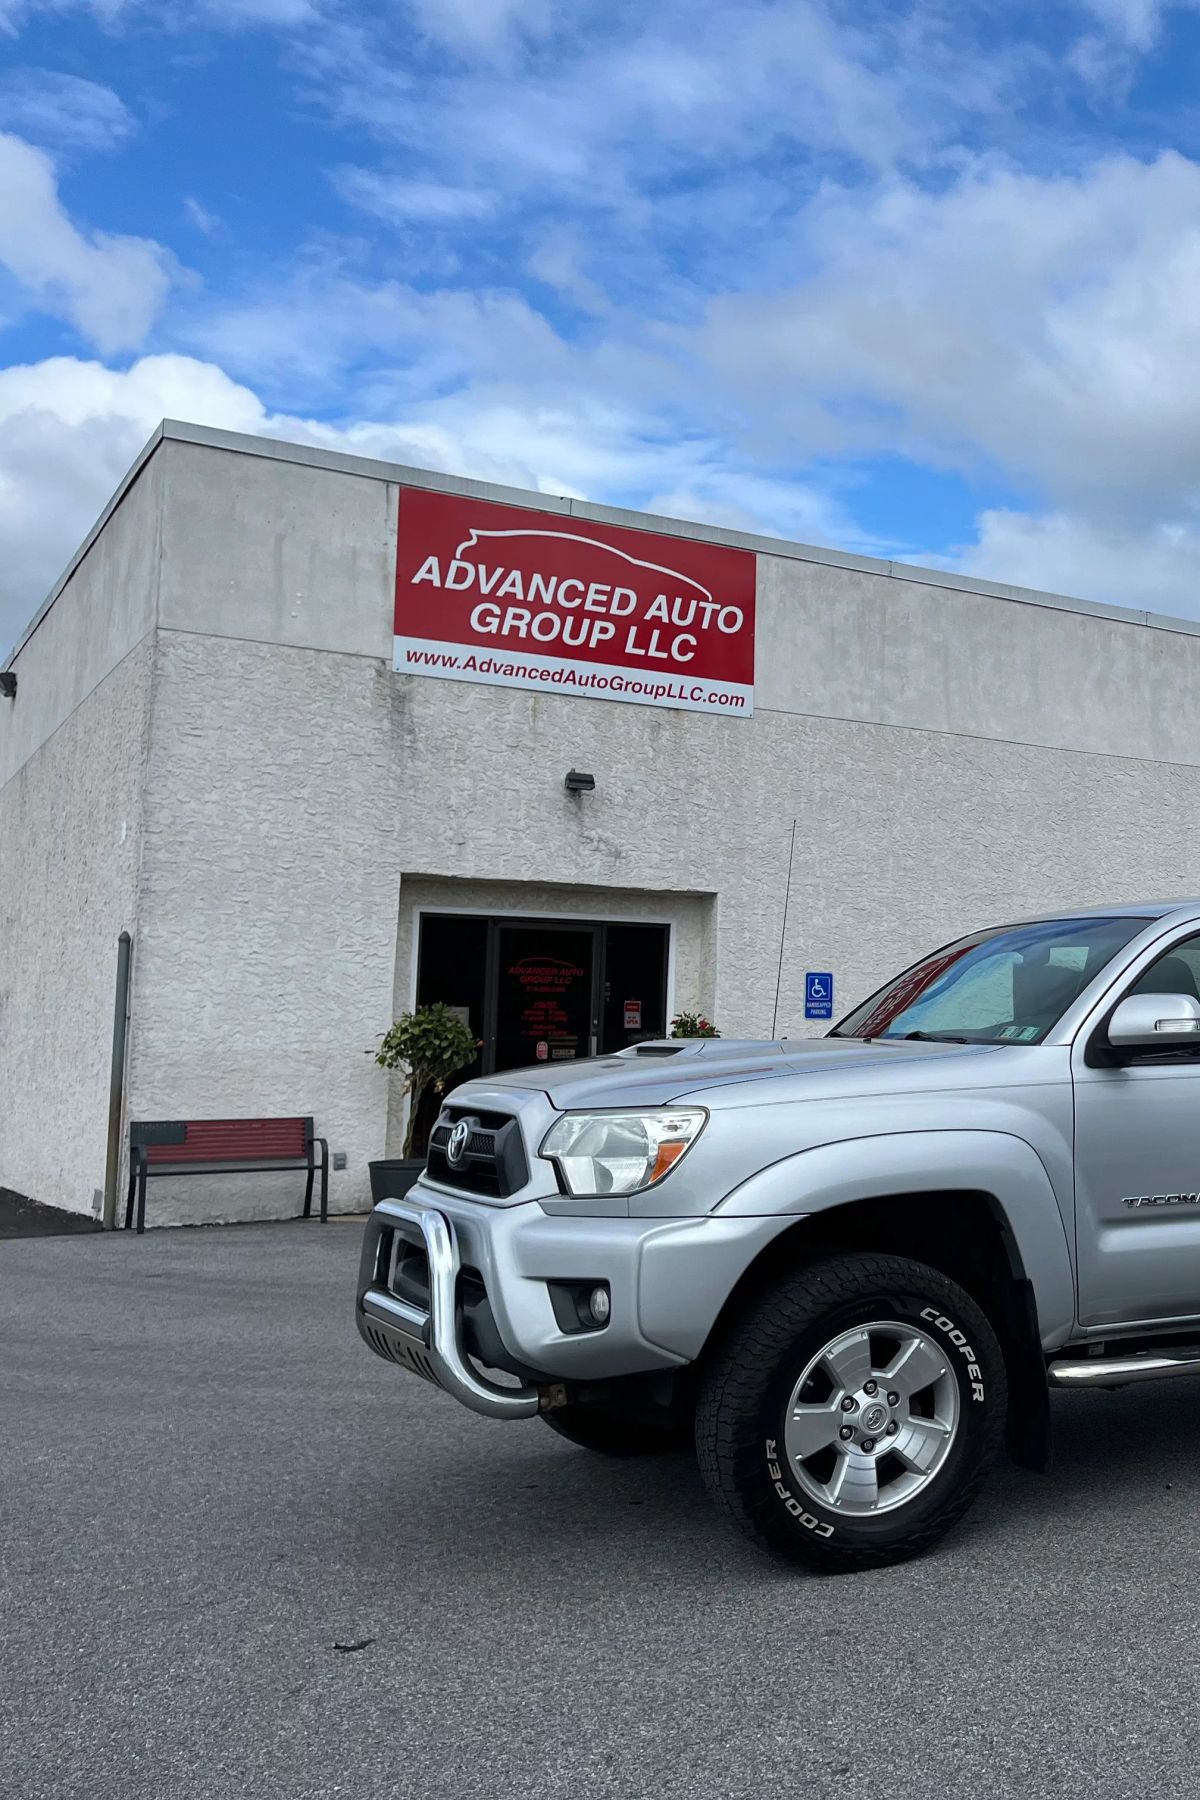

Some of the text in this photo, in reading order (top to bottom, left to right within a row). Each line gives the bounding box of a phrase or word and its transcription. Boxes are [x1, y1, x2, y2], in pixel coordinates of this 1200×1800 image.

[411, 556, 744, 634] ADVANCED AUTO
[470, 602, 698, 662] GROUP LLC
[405, 647, 746, 708] www.AdvancedAutoGroupLLC.com
[919, 1307, 985, 1402] COOPER
[765, 1439, 835, 1538] COOPER
